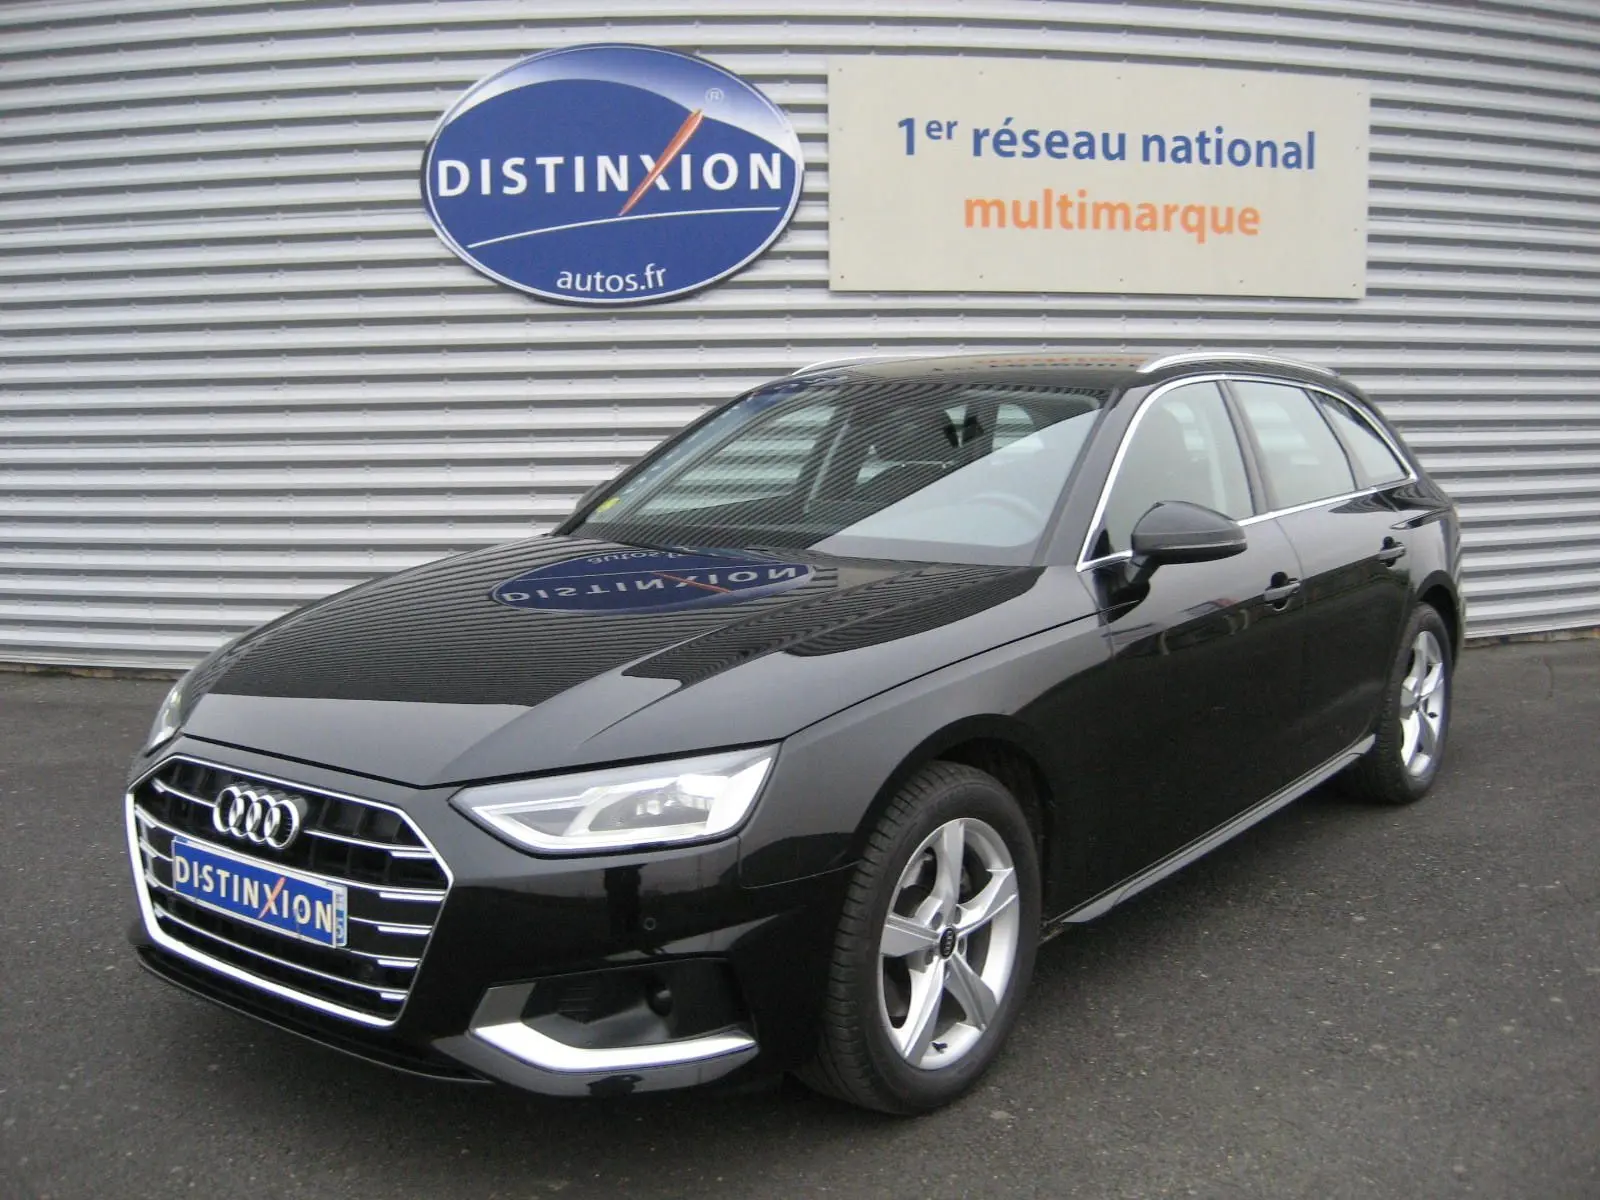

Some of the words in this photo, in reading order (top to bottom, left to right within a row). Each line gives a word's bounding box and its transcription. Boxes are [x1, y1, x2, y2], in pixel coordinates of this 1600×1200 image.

[898, 117, 957, 156] 1er
[972, 117, 1127, 161] réseau
[1141, 127, 1316, 170] national
[437, 152, 782, 197] DISTINXION
[964, 188, 1261, 244] multimarque
[556, 262, 667, 293] autos.fr
[174, 855, 333, 934] DISTINXION
